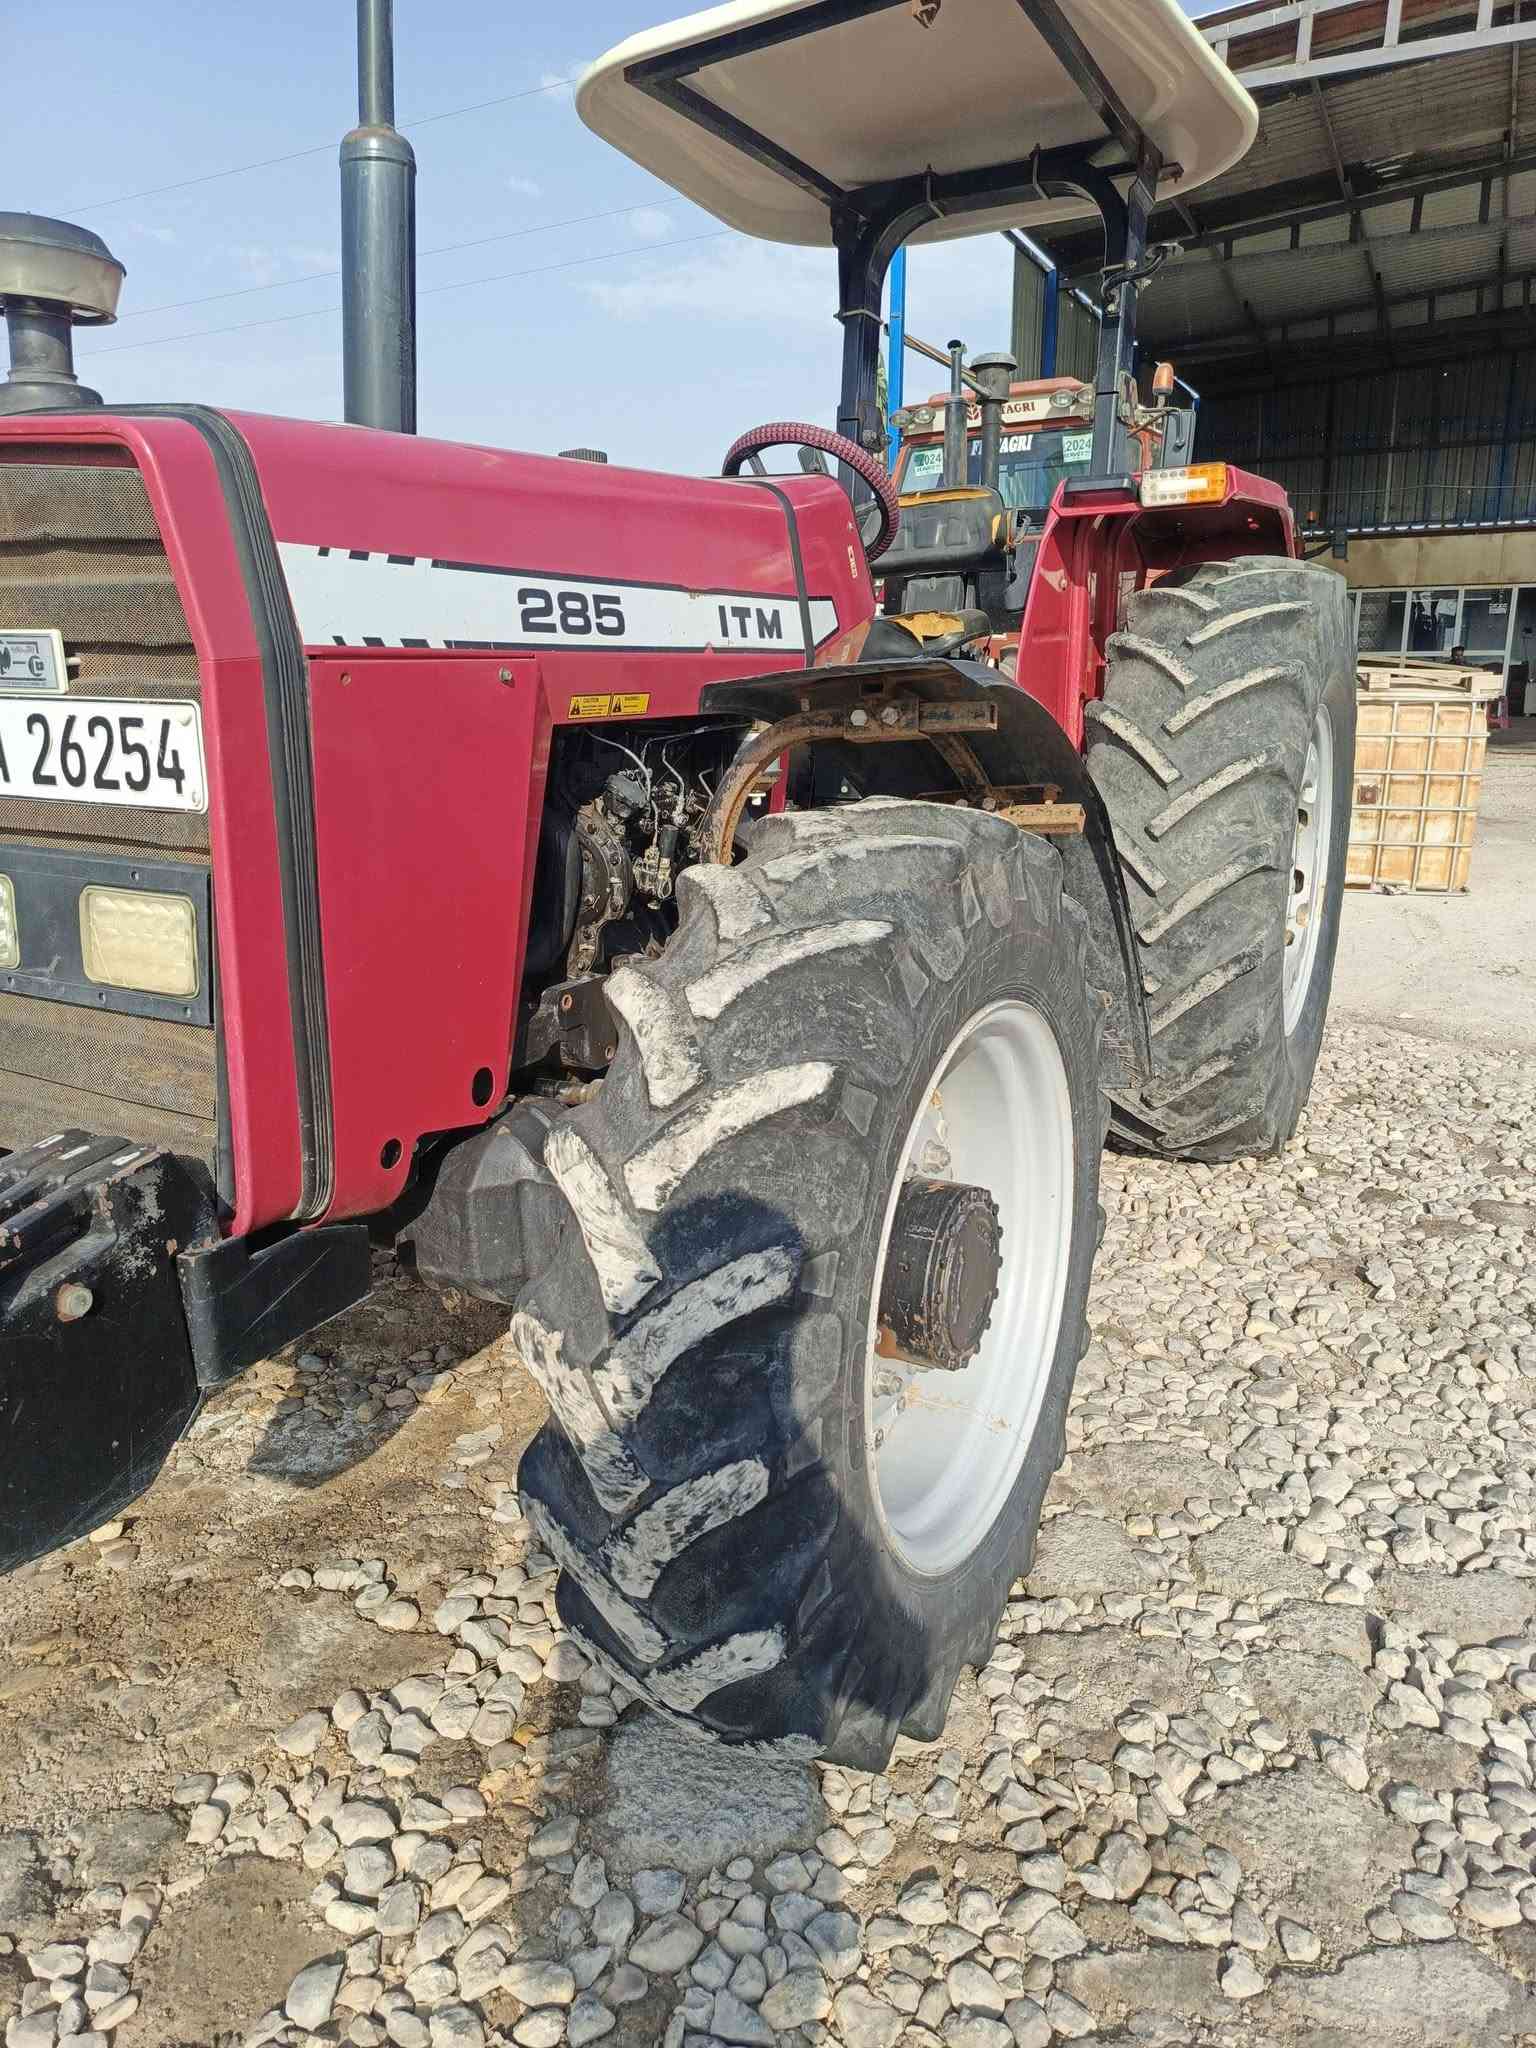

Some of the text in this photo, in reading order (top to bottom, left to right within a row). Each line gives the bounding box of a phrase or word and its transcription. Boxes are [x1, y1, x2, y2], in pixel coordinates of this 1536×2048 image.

[1001, 401, 1035, 415] TAGRI
[1065, 439, 1091, 451] 2024
[517, 588, 625, 636] 285
[718, 604, 783, 639] ITM
[26, 713, 185, 794] 26254
